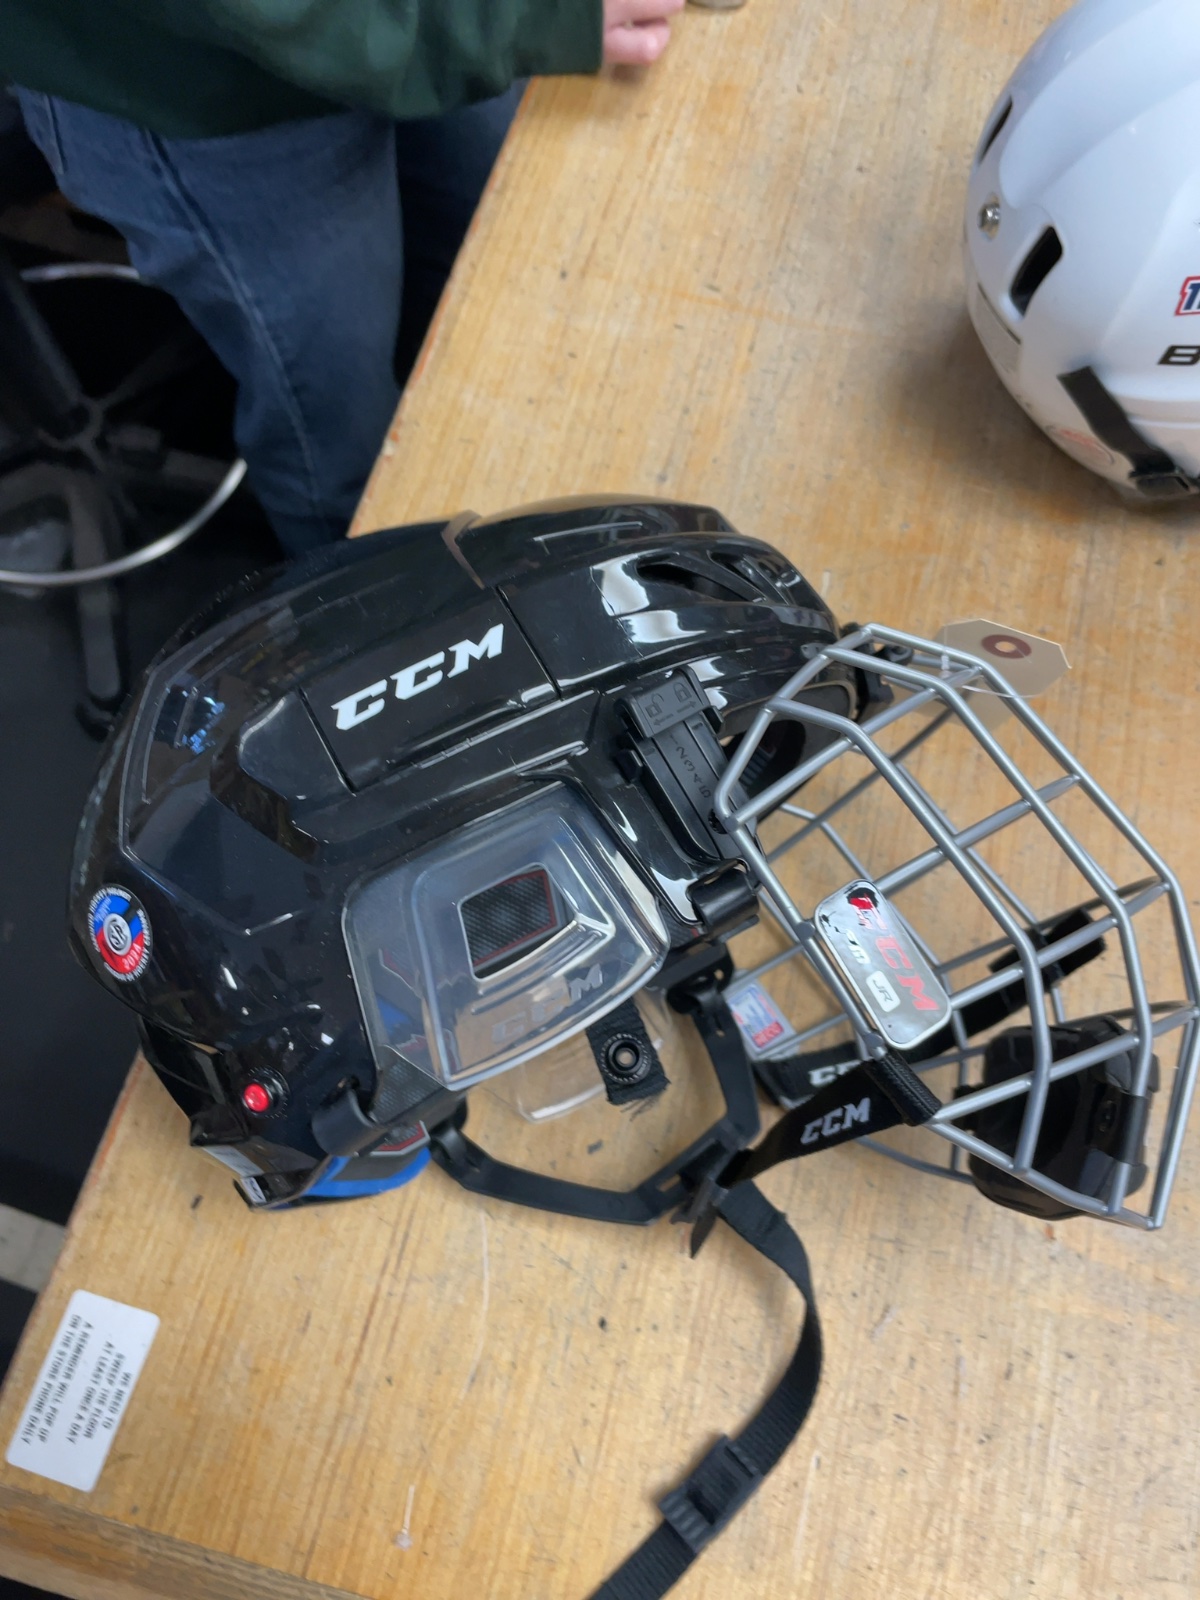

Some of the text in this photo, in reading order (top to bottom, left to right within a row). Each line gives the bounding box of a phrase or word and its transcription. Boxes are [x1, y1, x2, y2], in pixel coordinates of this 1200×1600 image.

[331, 623, 504, 731] CCM
[871, 978, 894, 1003] JR
[800, 1097, 871, 1144] CCM
[62, 1330, 91, 1380] REMINDER
[102, 1340, 116, 1356] AT
[20, 1313, 82, 1446] ON THE STORE PHONE DAILY
[90, 1355, 109, 1385] LEAST
[52, 1381, 69, 1404] WILL
[78, 1385, 97, 1412] ONCE
[83, 1352, 127, 1439] SWEEP THE FLOOR
[101, 1371, 132, 1430] WE NEED TO
[44, 1404, 60, 1427] POP
[37, 1427, 50, 1444] UP
[64, 1422, 82, 1445] DAY
